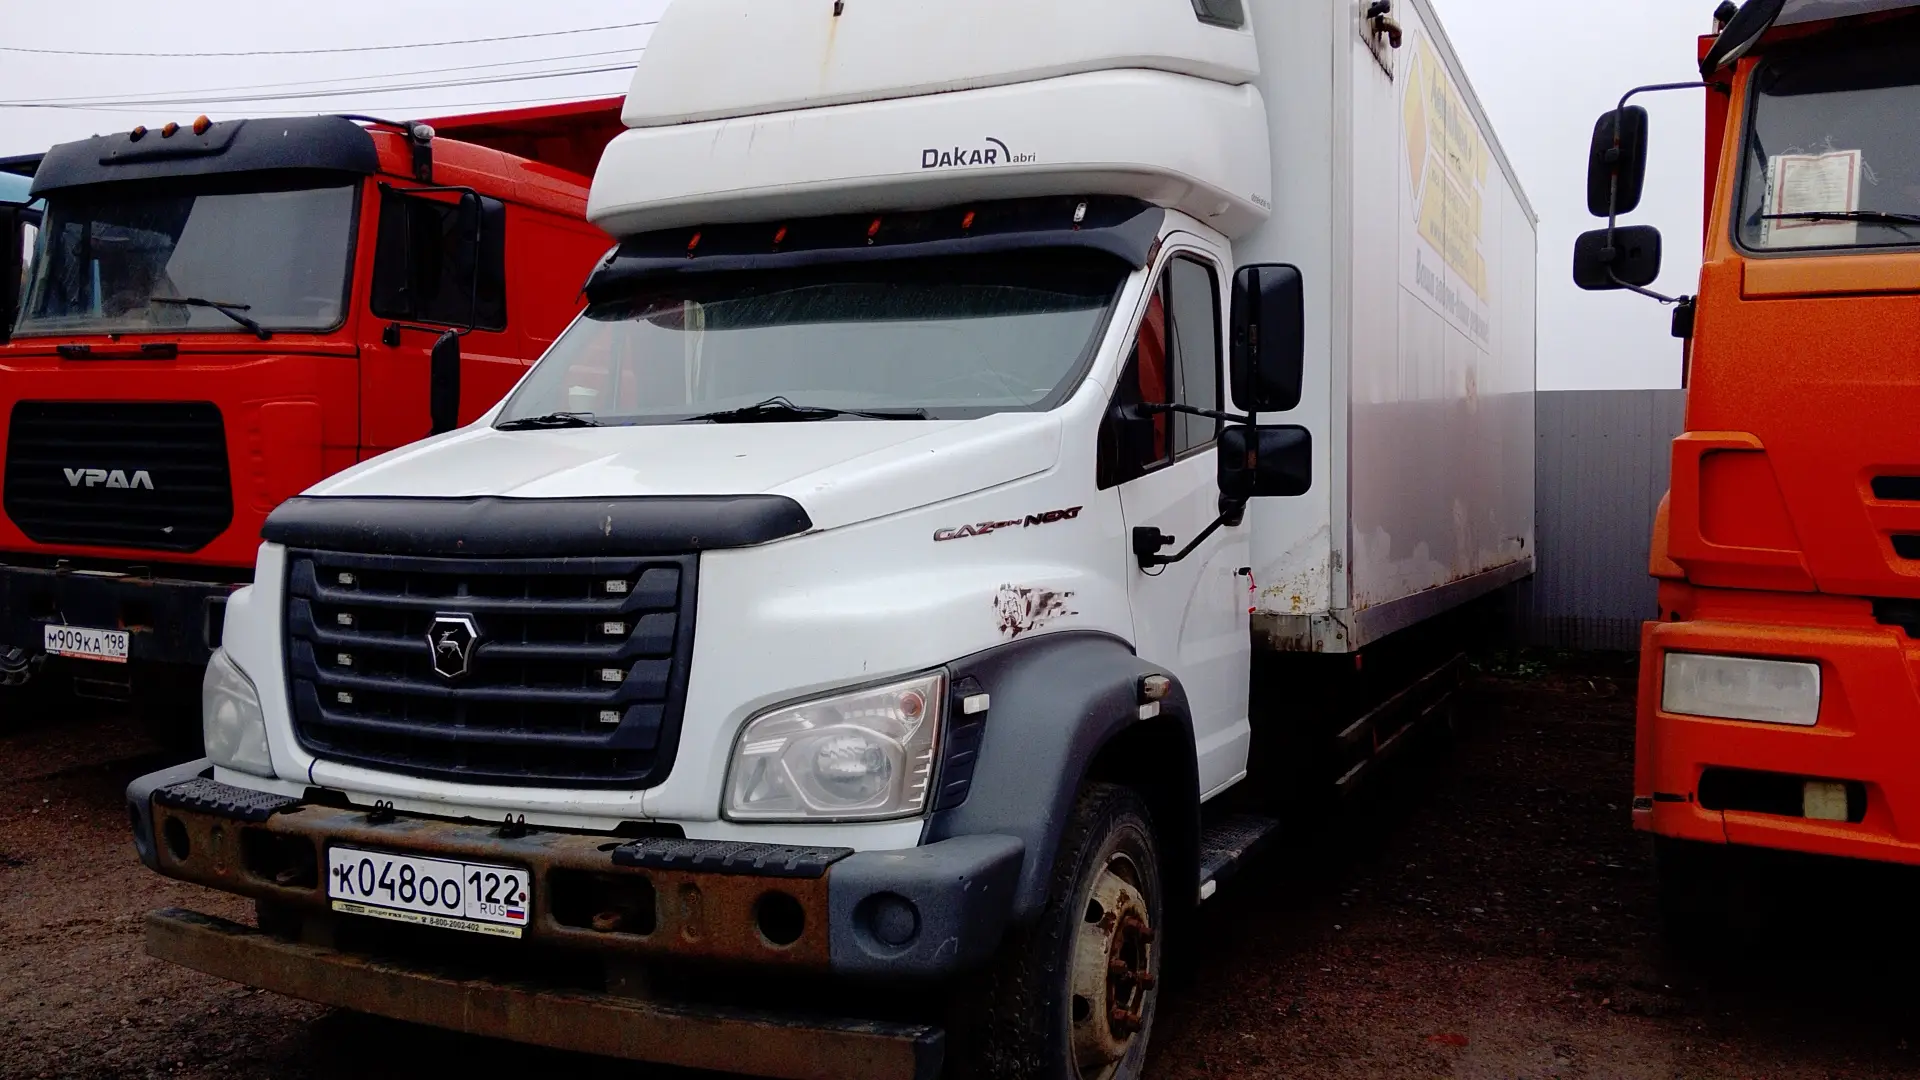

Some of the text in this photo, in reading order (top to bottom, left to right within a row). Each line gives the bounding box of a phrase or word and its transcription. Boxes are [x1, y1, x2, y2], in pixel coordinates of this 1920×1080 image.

[1013, 152, 1036, 163] abri
[63, 468, 154, 490] УРАЛ
[104, 634, 124, 650] 198
[468, 871, 520, 906] 122
[479, 902, 505, 917] RUS
[429, 917, 480, 932] 8-800-2002-402
